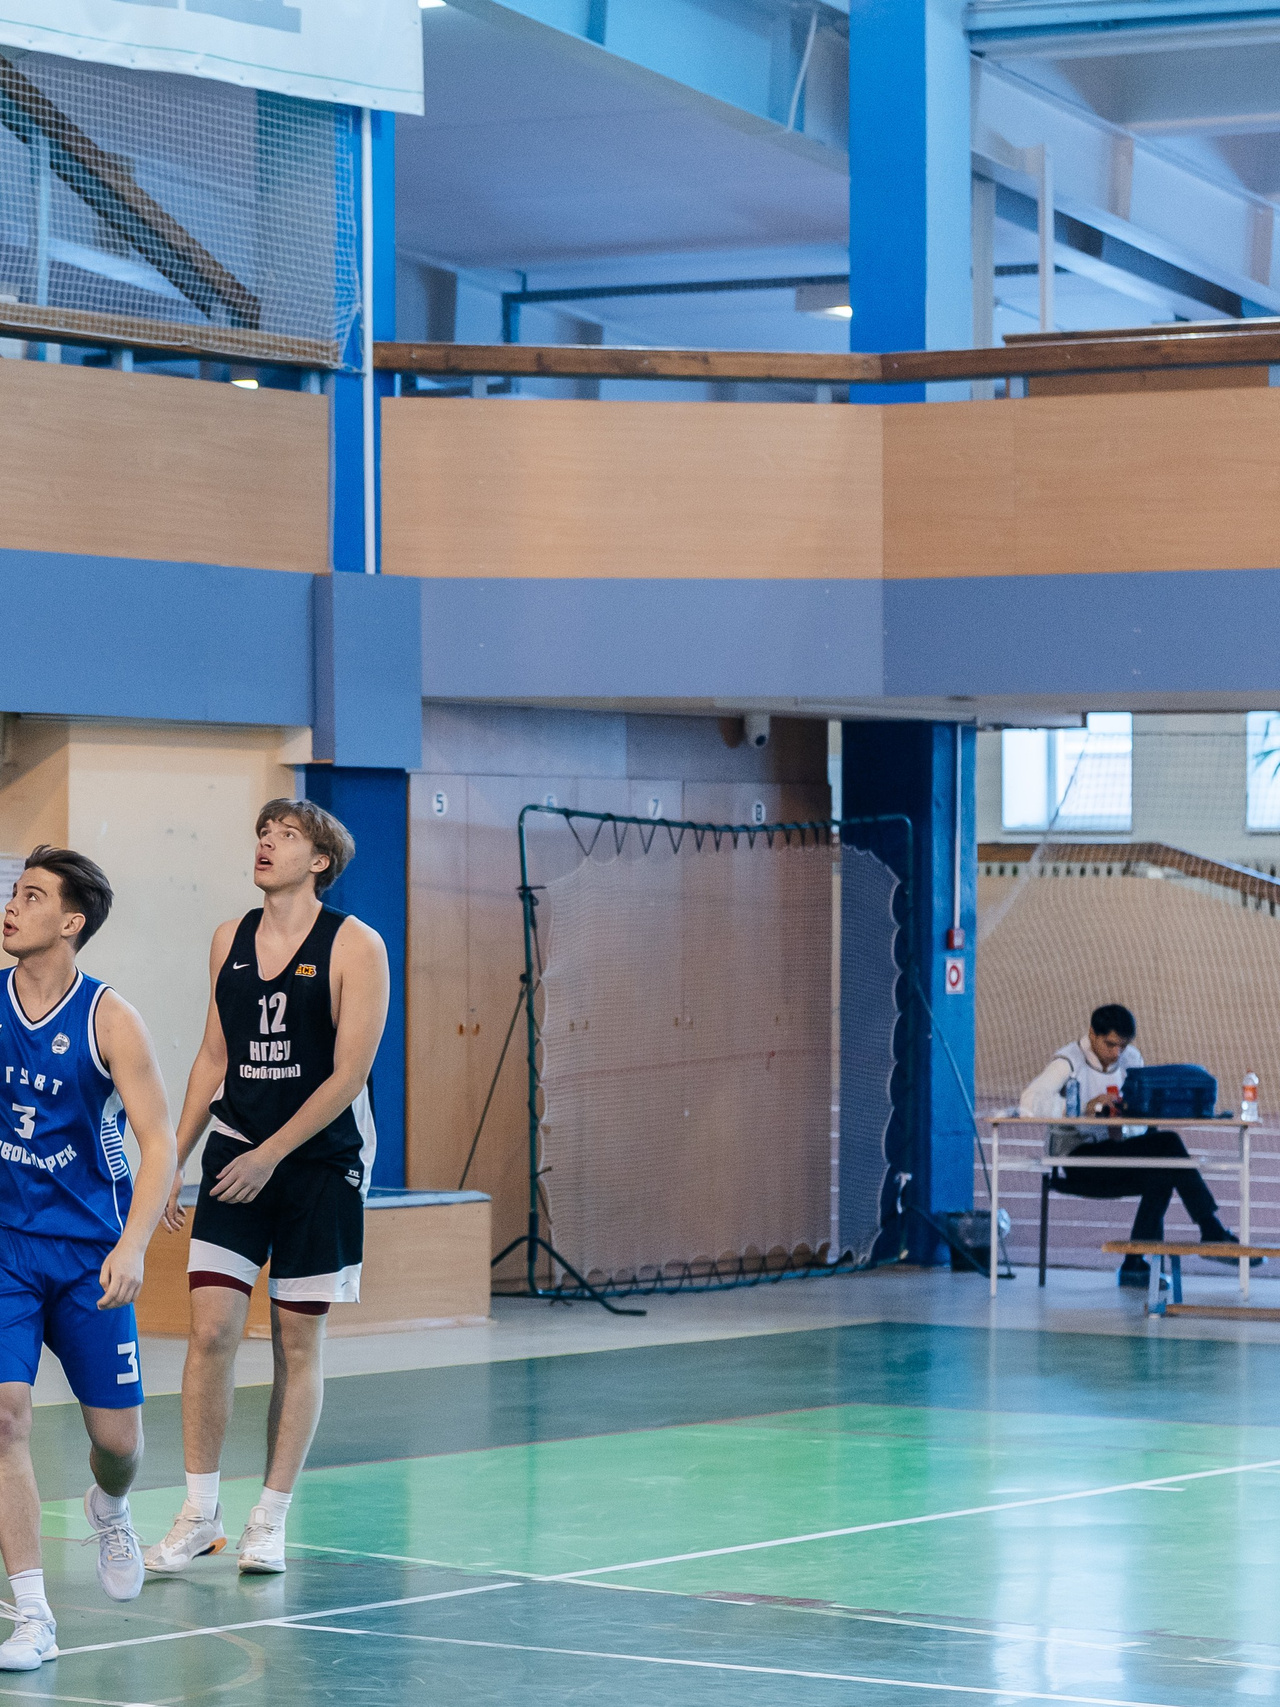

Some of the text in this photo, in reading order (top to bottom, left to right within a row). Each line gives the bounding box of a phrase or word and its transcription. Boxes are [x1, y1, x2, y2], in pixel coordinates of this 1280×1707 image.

[258, 991, 287, 1035] 12
[249, 1040, 291, 1062] НГАСУ
[239, 1063, 301, 1080] (Сибтрин)
[12, 1102, 36, 1139] 3
[117, 1340, 140, 1385] 3
